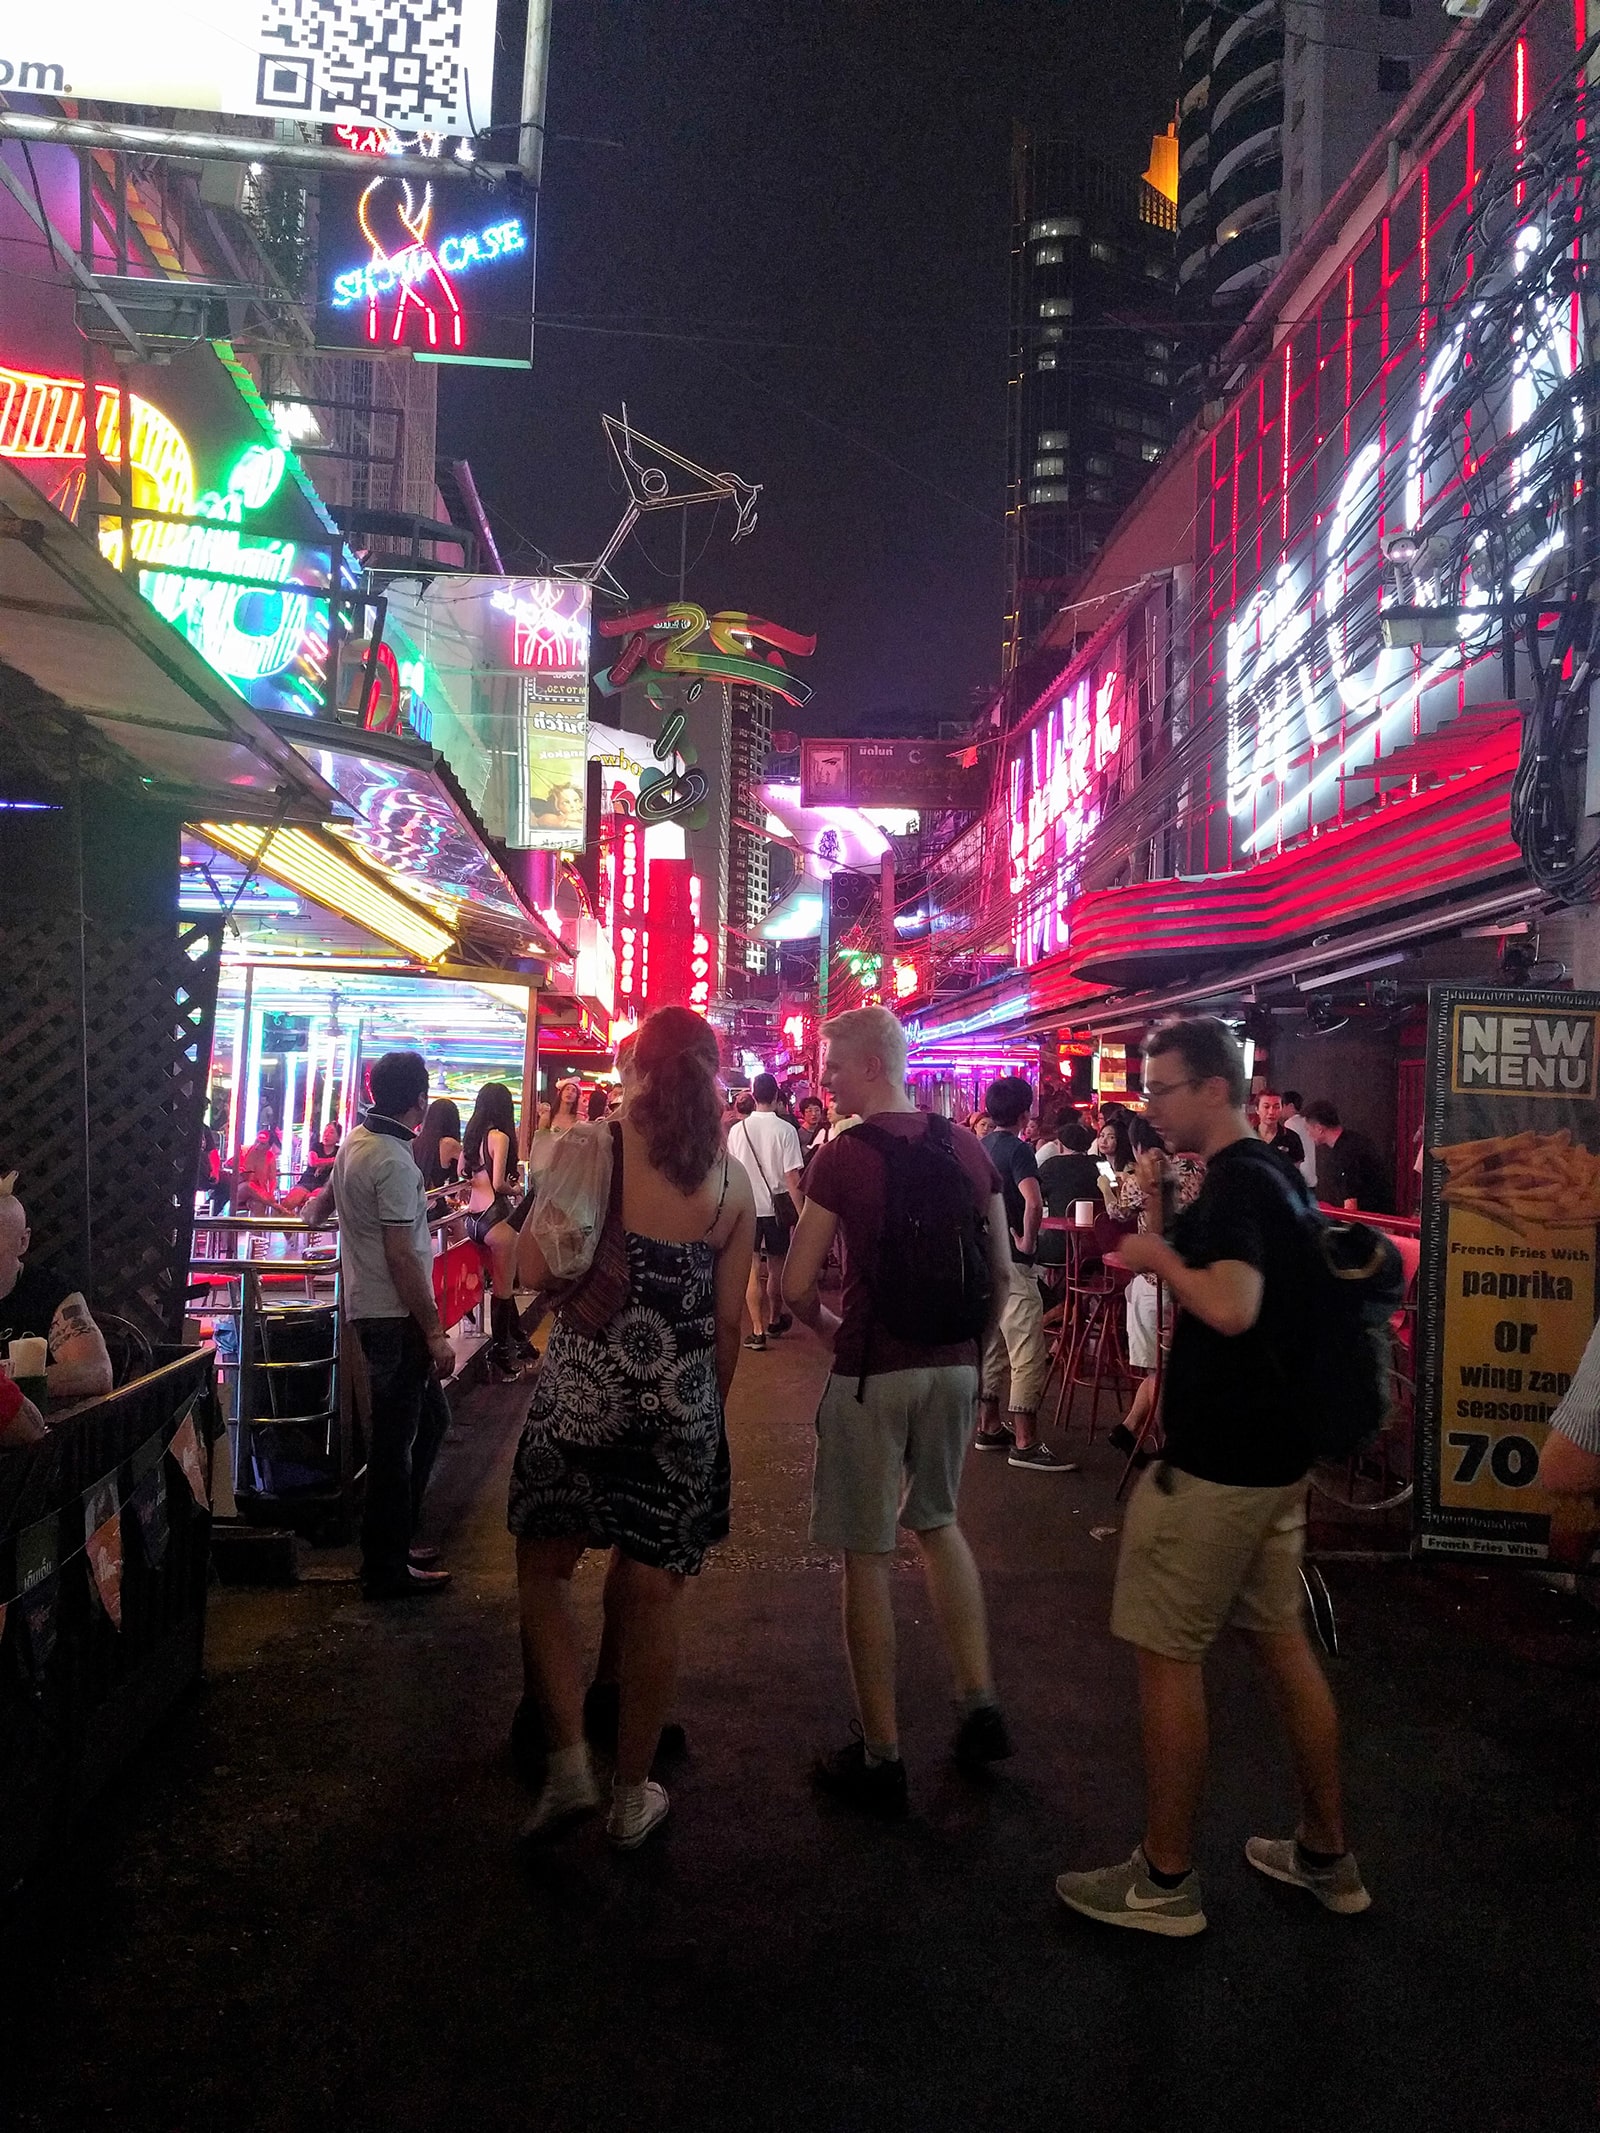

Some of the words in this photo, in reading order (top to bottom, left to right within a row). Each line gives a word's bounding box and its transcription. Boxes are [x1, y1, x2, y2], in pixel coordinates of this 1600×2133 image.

[439, 219, 525, 271] CASE
[1462, 1016, 1590, 1057] NEW
[1463, 1053, 1587, 1088] MENU
[1451, 1242, 1505, 1257] French
[1510, 1246, 1547, 1260] Fries
[1551, 1248, 1590, 1262] With
[1462, 1270, 1574, 1301] paprika
[1494, 1320, 1538, 1354] or
[1459, 1363, 1522, 1393] wing
[1448, 1432, 1540, 1488] 70
[1428, 1537, 1470, 1550] French
[1473, 1541, 1503, 1553] Fries
[1507, 1544, 1538, 1556] With
